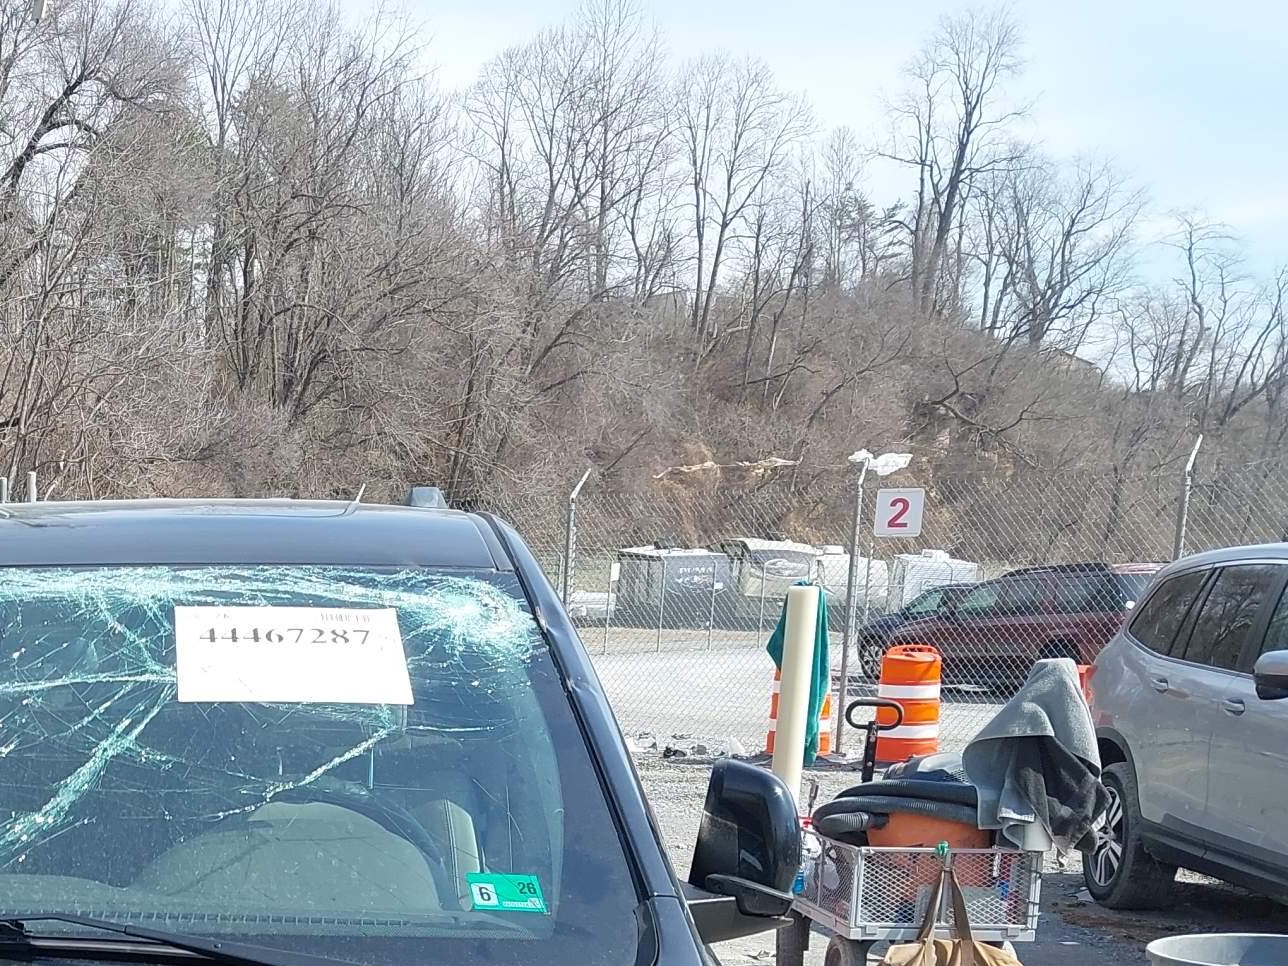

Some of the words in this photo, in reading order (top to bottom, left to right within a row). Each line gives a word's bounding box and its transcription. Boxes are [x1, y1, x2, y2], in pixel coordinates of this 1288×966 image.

[887, 497, 910, 527] 2
[200, 627, 370, 644] 44467287
[479, 886, 491, 901] 6
[517, 882, 537, 894] 26
